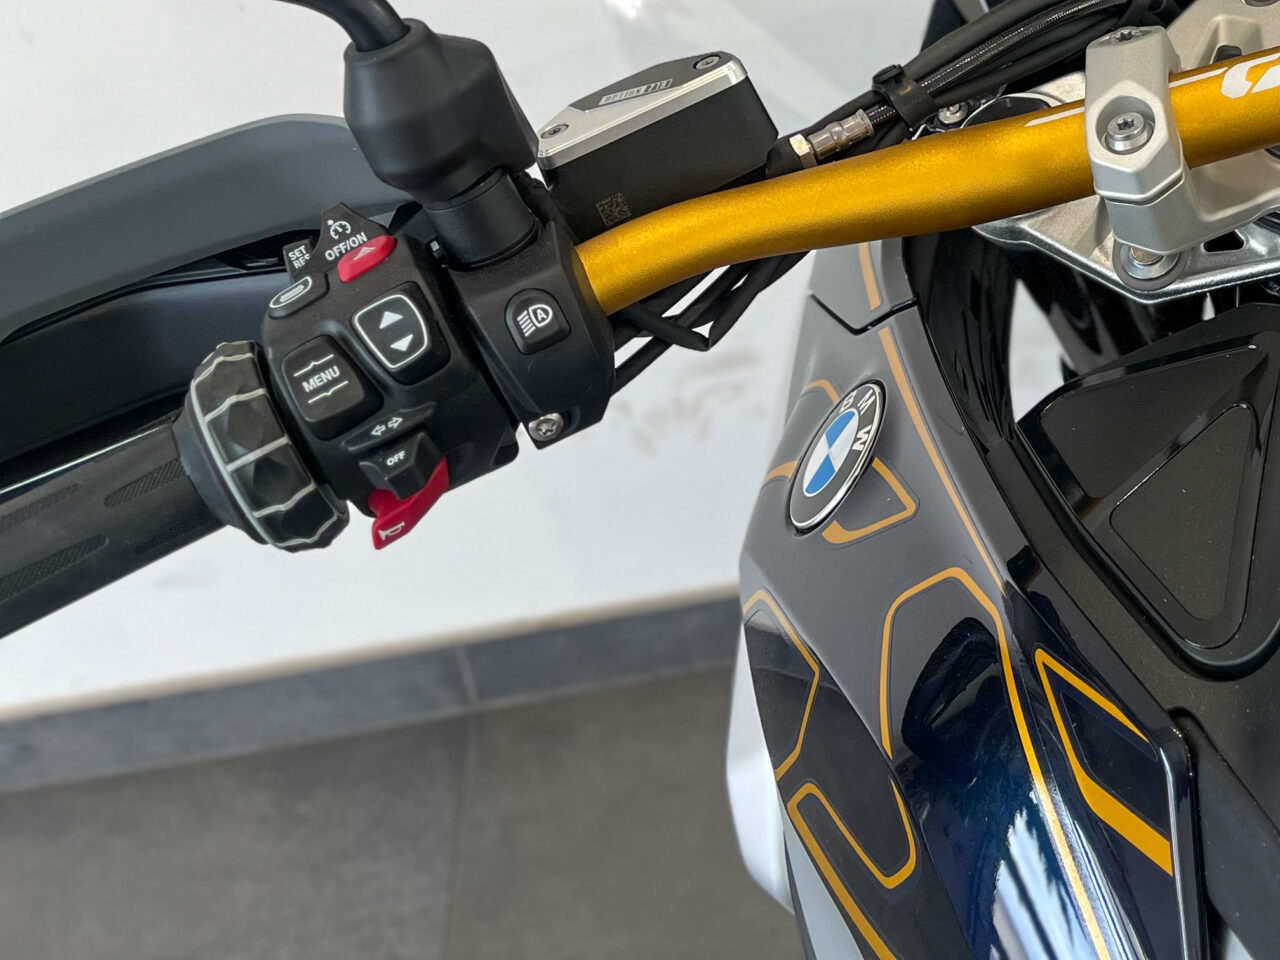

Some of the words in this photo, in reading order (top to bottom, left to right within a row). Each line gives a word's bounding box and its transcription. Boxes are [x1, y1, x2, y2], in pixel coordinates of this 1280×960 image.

[288, 245, 307, 261] SET
[324, 232, 368, 261] OFF/ON
[302, 365, 340, 392] MENU
[839, 389, 876, 452] BMW
[386, 450, 406, 466] OFF
